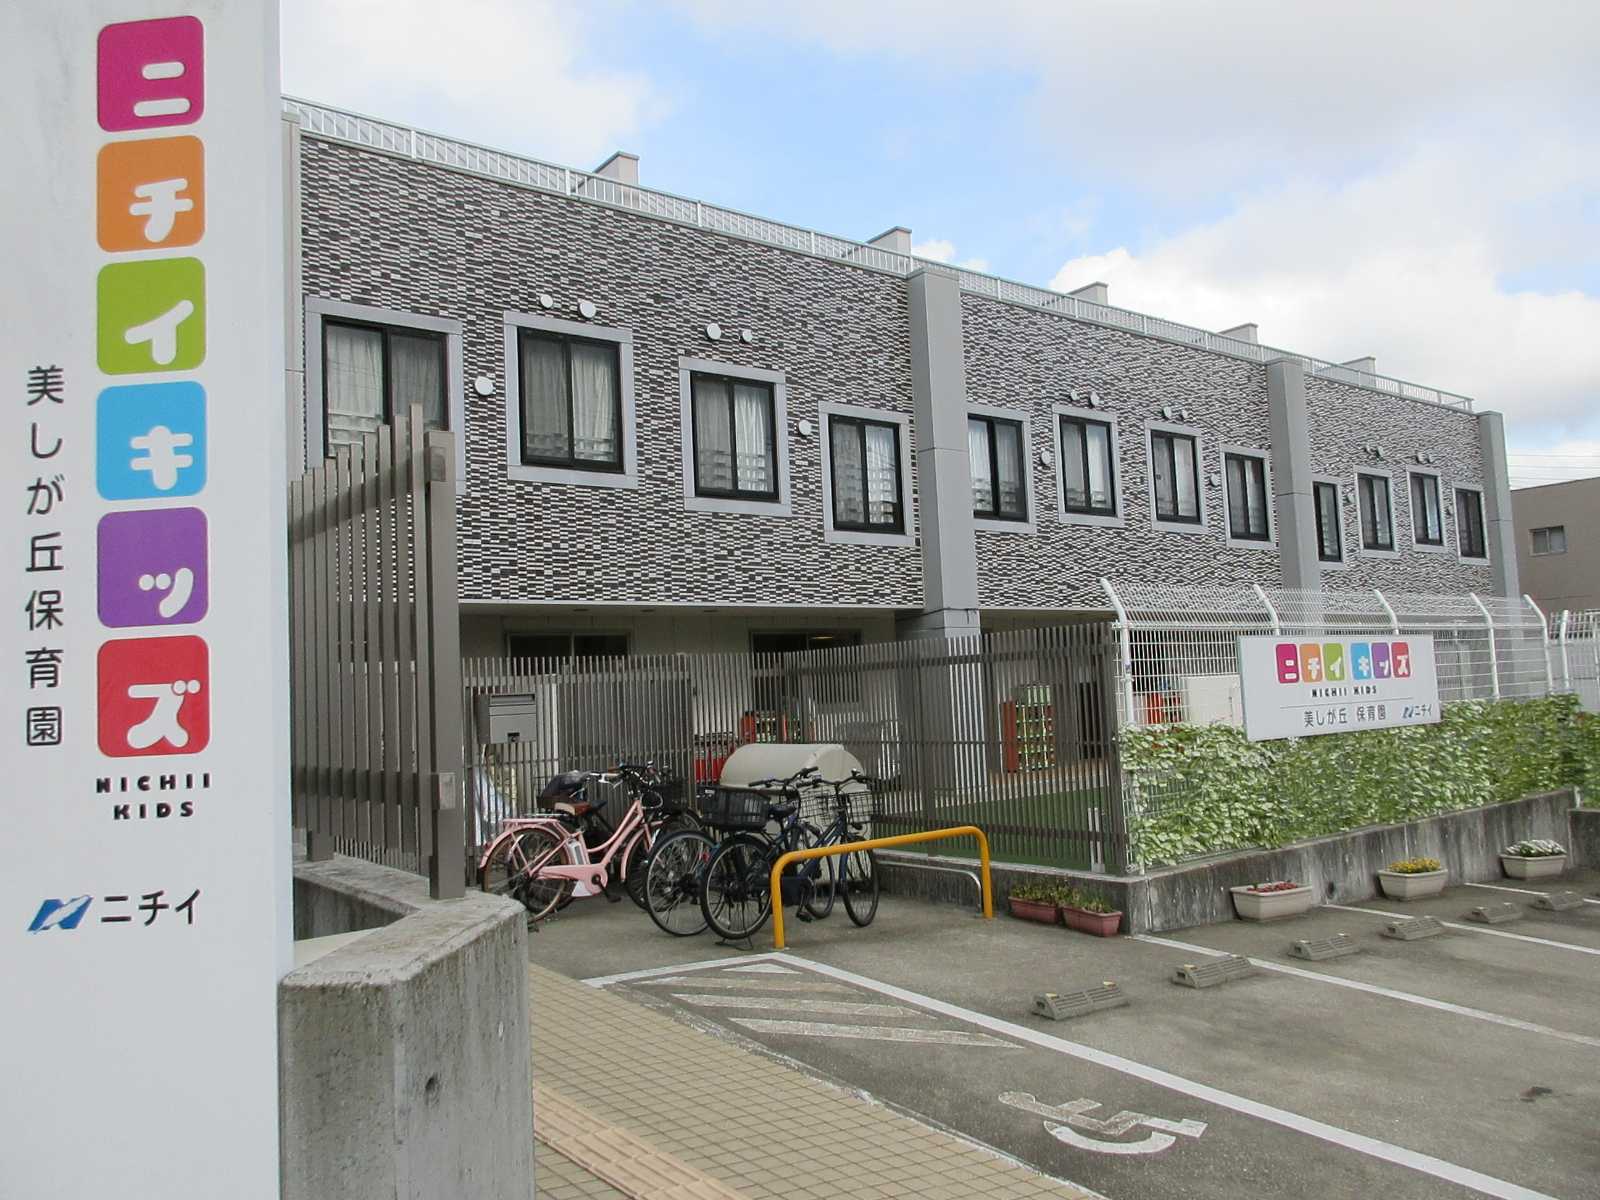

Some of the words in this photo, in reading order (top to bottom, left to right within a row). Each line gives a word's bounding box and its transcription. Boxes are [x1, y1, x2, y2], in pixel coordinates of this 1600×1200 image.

[123, 60, 201, 749] ニチイキッズ
[25, 364, 65, 747] 美しが丘保育園
[1311, 686, 1347, 698] NICHII
[1353, 684, 1378, 696] KIDS
[96, 772, 212, 794] NICHII
[112, 800, 196, 821] KIDS
[100, 888, 202, 926] ニチイ
